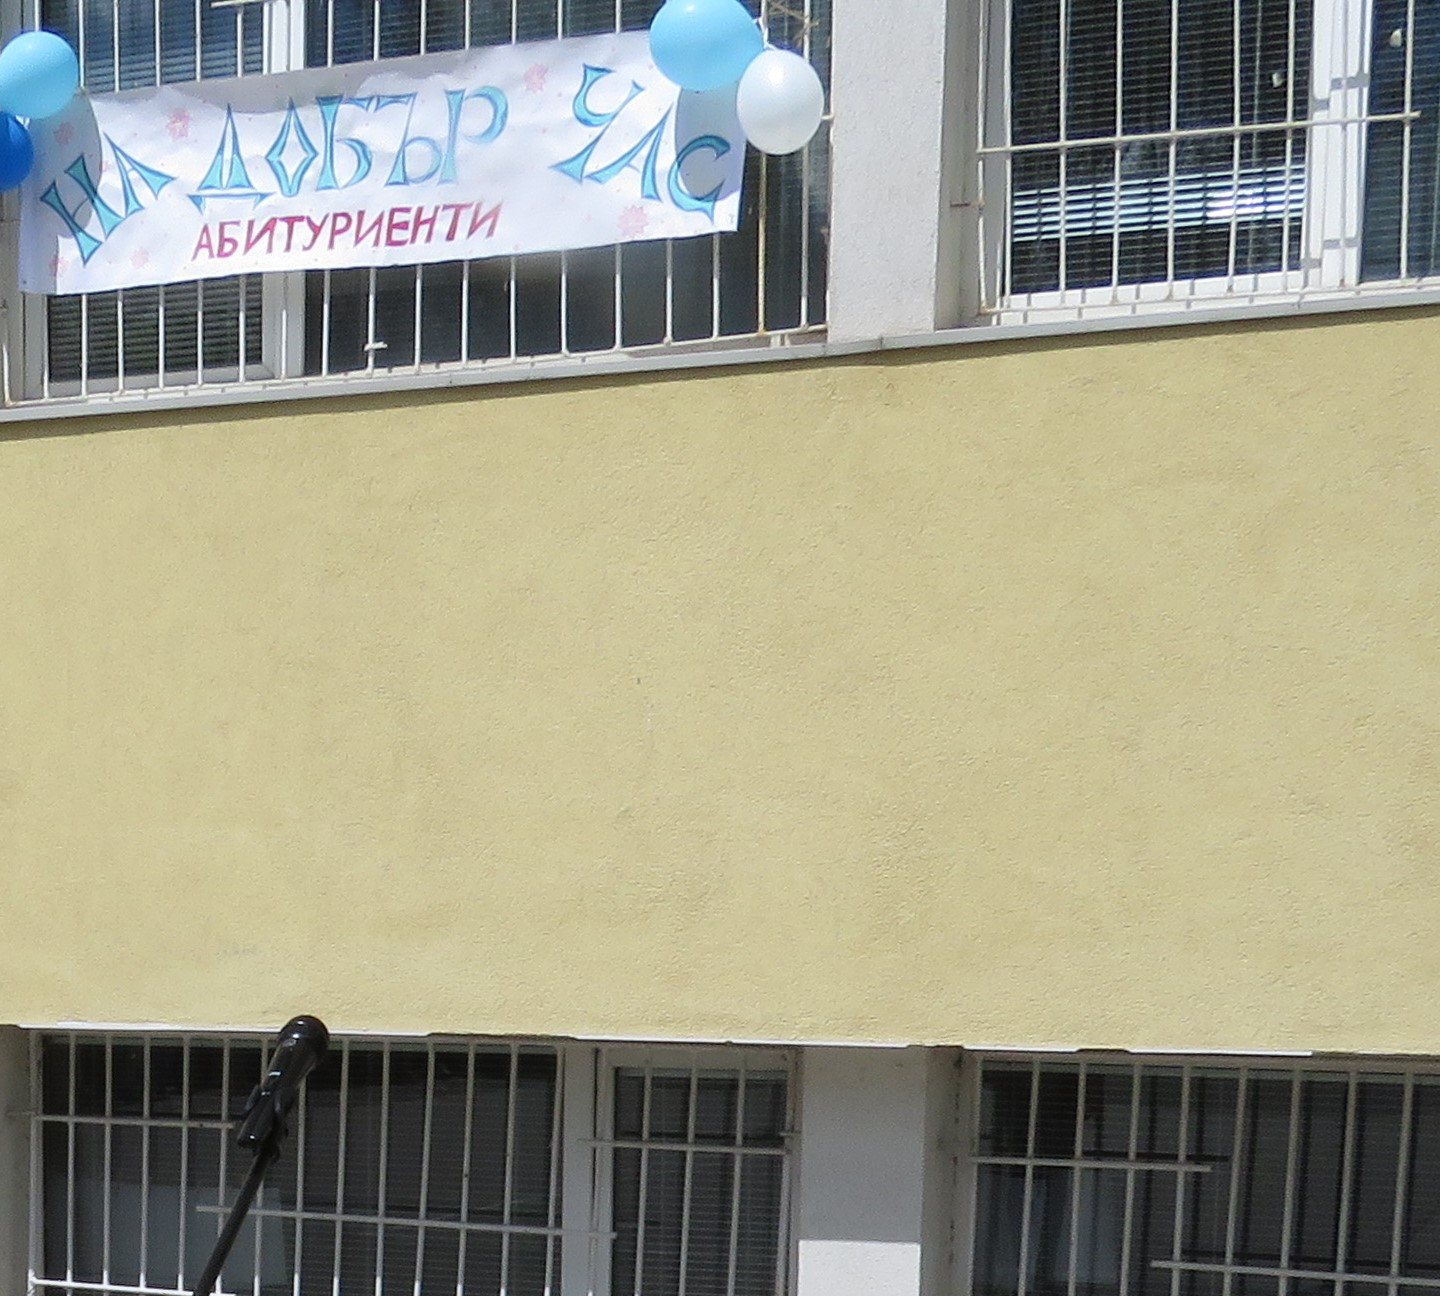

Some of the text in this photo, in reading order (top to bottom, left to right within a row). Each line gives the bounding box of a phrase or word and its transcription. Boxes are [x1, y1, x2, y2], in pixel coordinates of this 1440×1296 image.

[40, 62, 731, 268] НА ДОБЪР ЧАС
[191, 201, 503, 262] АБИТУРИЕНТИ
